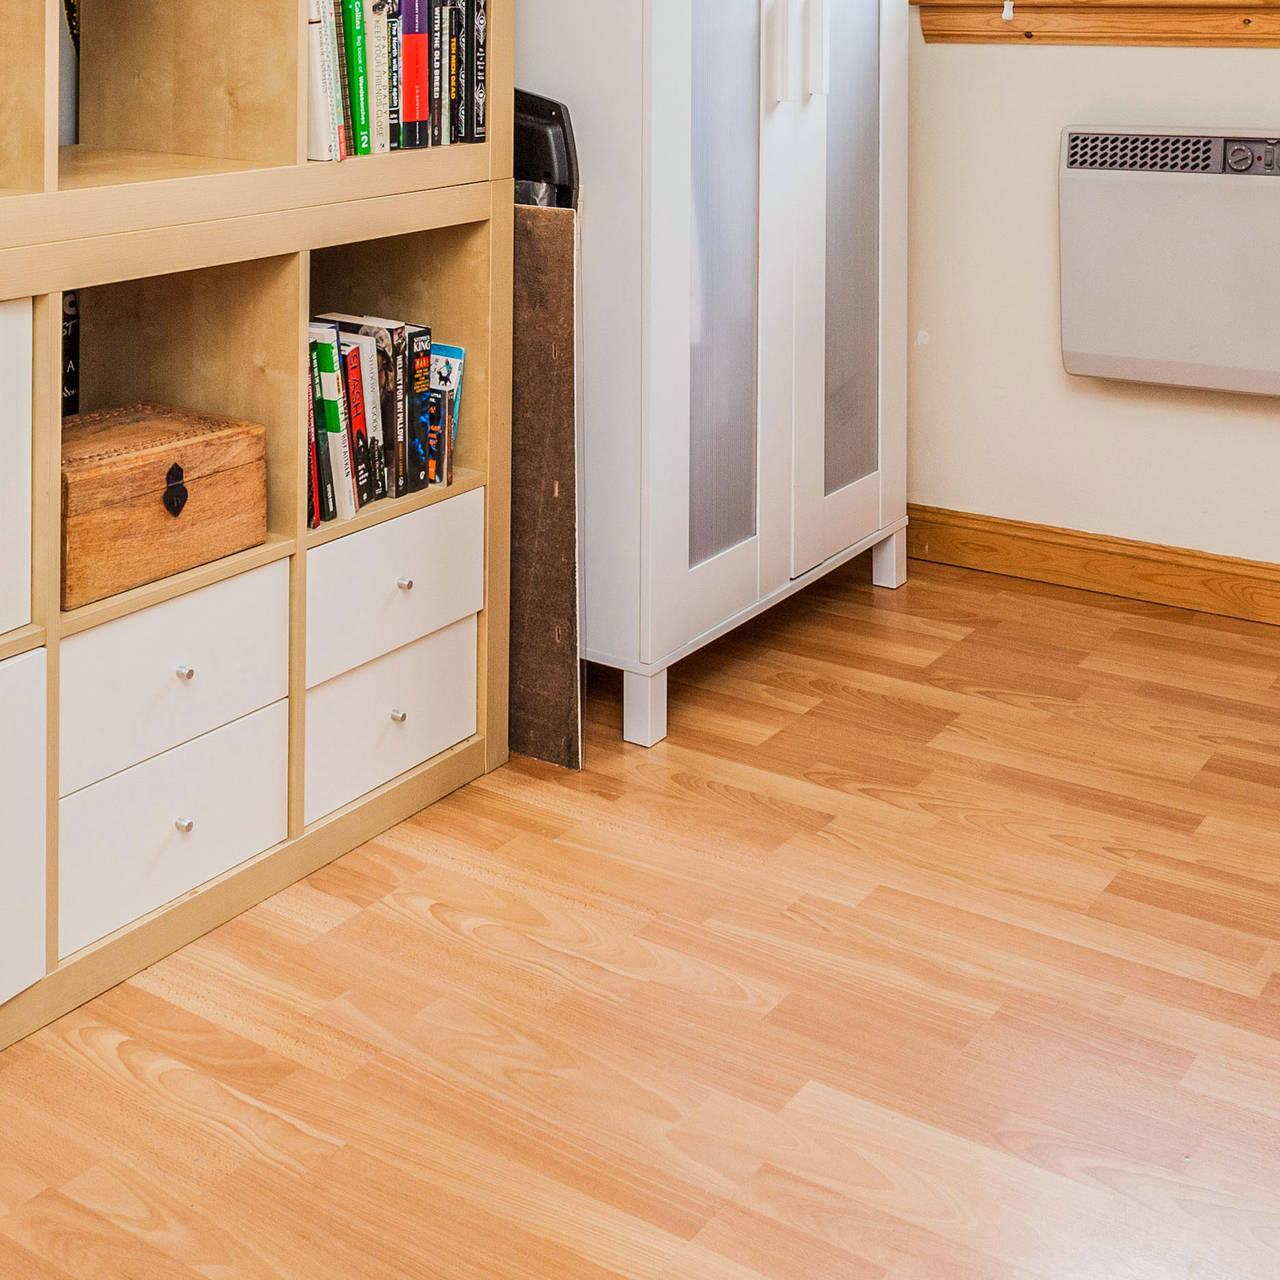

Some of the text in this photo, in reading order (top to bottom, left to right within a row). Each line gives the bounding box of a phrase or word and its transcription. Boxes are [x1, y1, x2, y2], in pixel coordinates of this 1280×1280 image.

[353, 0, 361, 30] Collins
[396, 354, 404, 385] HELMET
[396, 385, 404, 399] FOR
[396, 412, 404, 442] PILLOW
